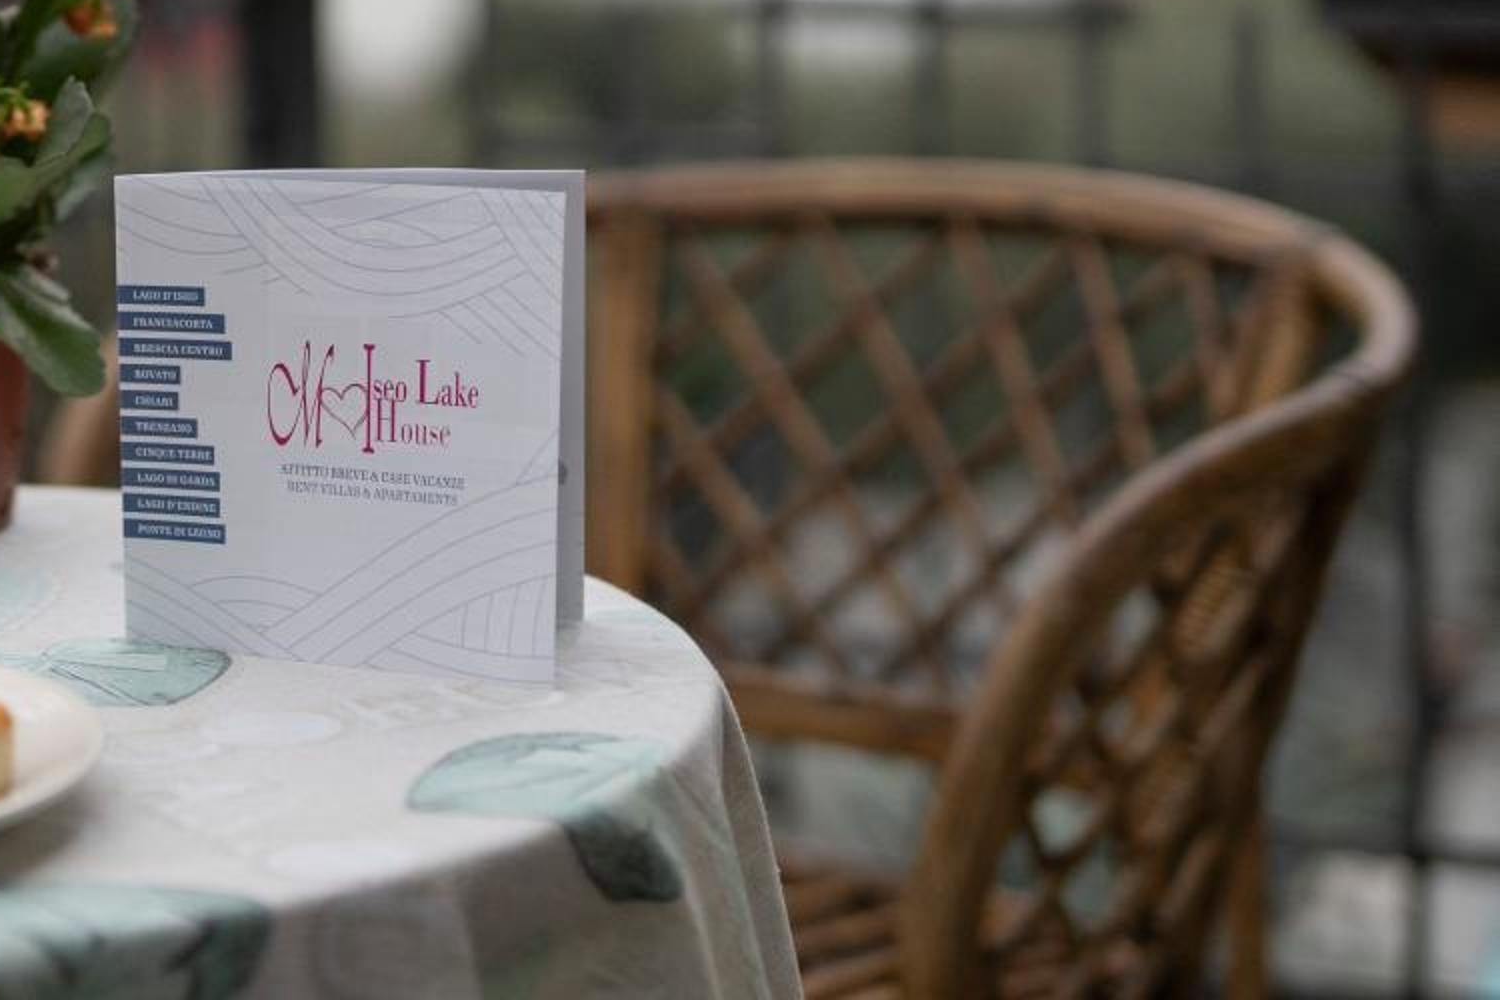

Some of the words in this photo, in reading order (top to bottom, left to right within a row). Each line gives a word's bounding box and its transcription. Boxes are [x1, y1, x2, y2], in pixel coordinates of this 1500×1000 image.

[132, 316, 214, 330] FRANCIACORTA
[132, 342, 179, 355] BRESCIA
[180, 344, 224, 357] CENTRO
[361, 343, 408, 454] Iseo
[415, 358, 480, 409] Lake
[373, 396, 451, 447] House
[135, 447, 176, 460] CINQUE
[137, 472, 164, 484] LAGO
[179, 474, 216, 487] GARDA
